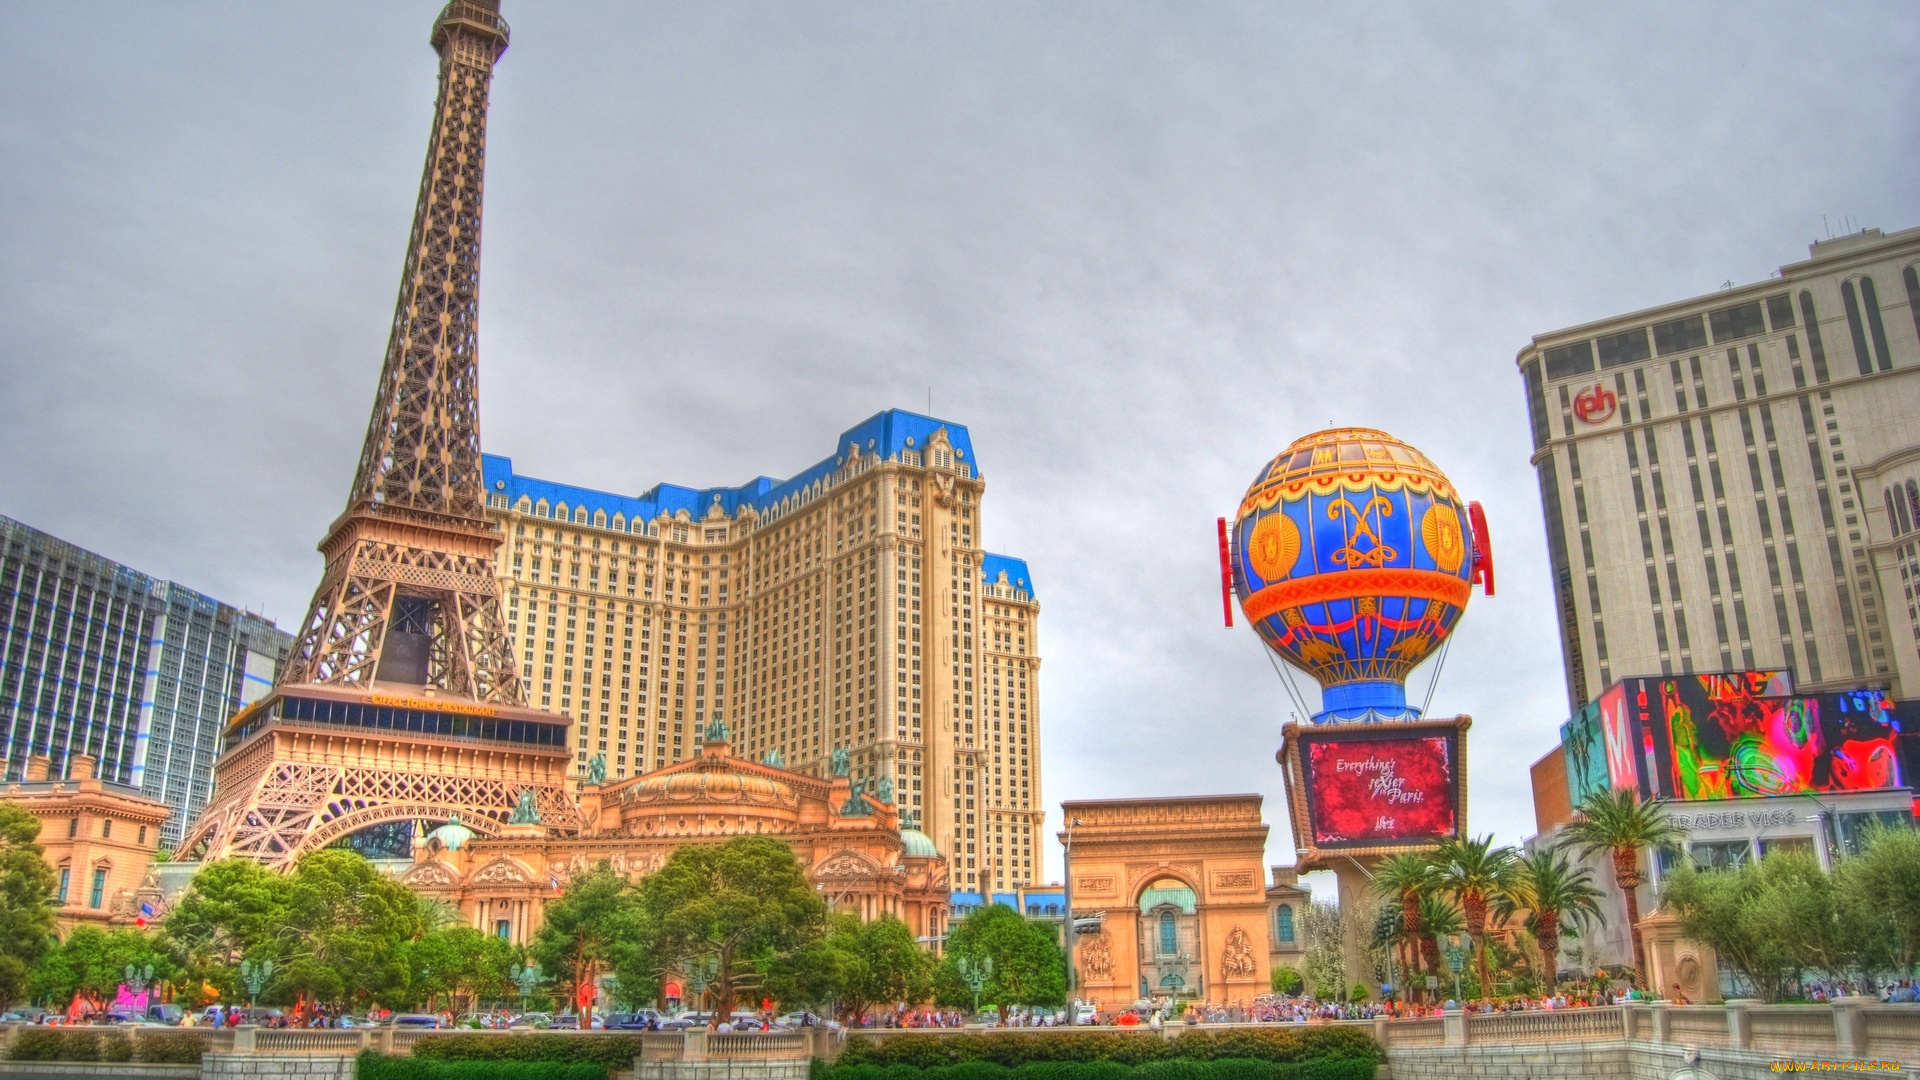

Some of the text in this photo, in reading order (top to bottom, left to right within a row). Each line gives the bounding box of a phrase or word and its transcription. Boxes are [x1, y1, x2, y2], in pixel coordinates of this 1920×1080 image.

[372, 694, 495, 716] EIFFEL TOWER RESTAURANT
[1336, 756, 1396, 777] Everything's
[1667, 813, 1745, 829] TRADER
